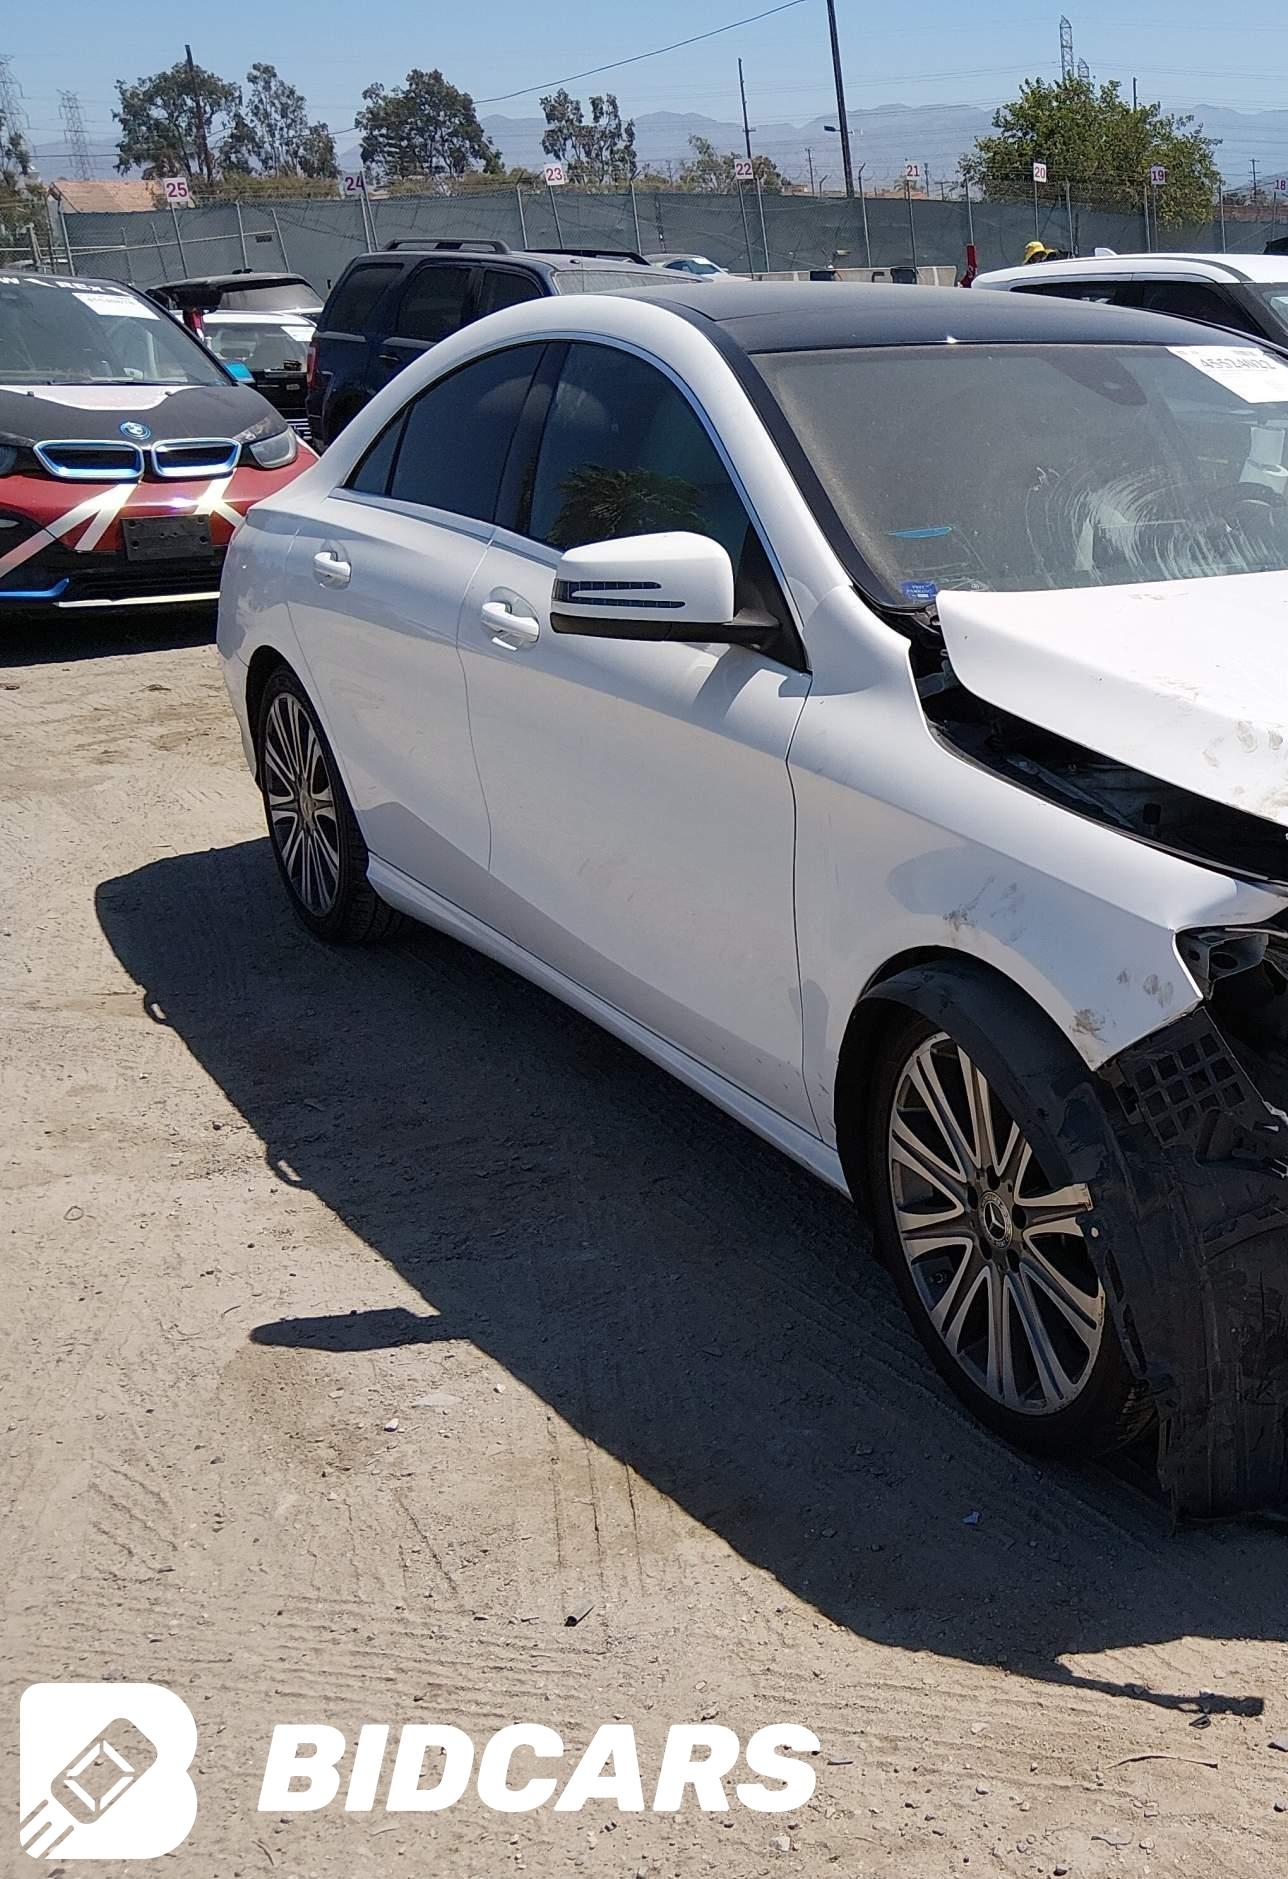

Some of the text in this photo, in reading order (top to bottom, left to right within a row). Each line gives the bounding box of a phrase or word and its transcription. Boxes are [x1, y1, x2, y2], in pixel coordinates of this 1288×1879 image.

[546, 167, 563, 182] 23
[736, 162, 753, 176] 22
[906, 164, 920, 177] 21
[1034, 166, 1046, 179] 20
[344, 174, 366, 191] 24
[1151, 170, 1164, 182] 19
[166, 181, 188, 198] 25
[1273, 179, 1287, 191] 18
